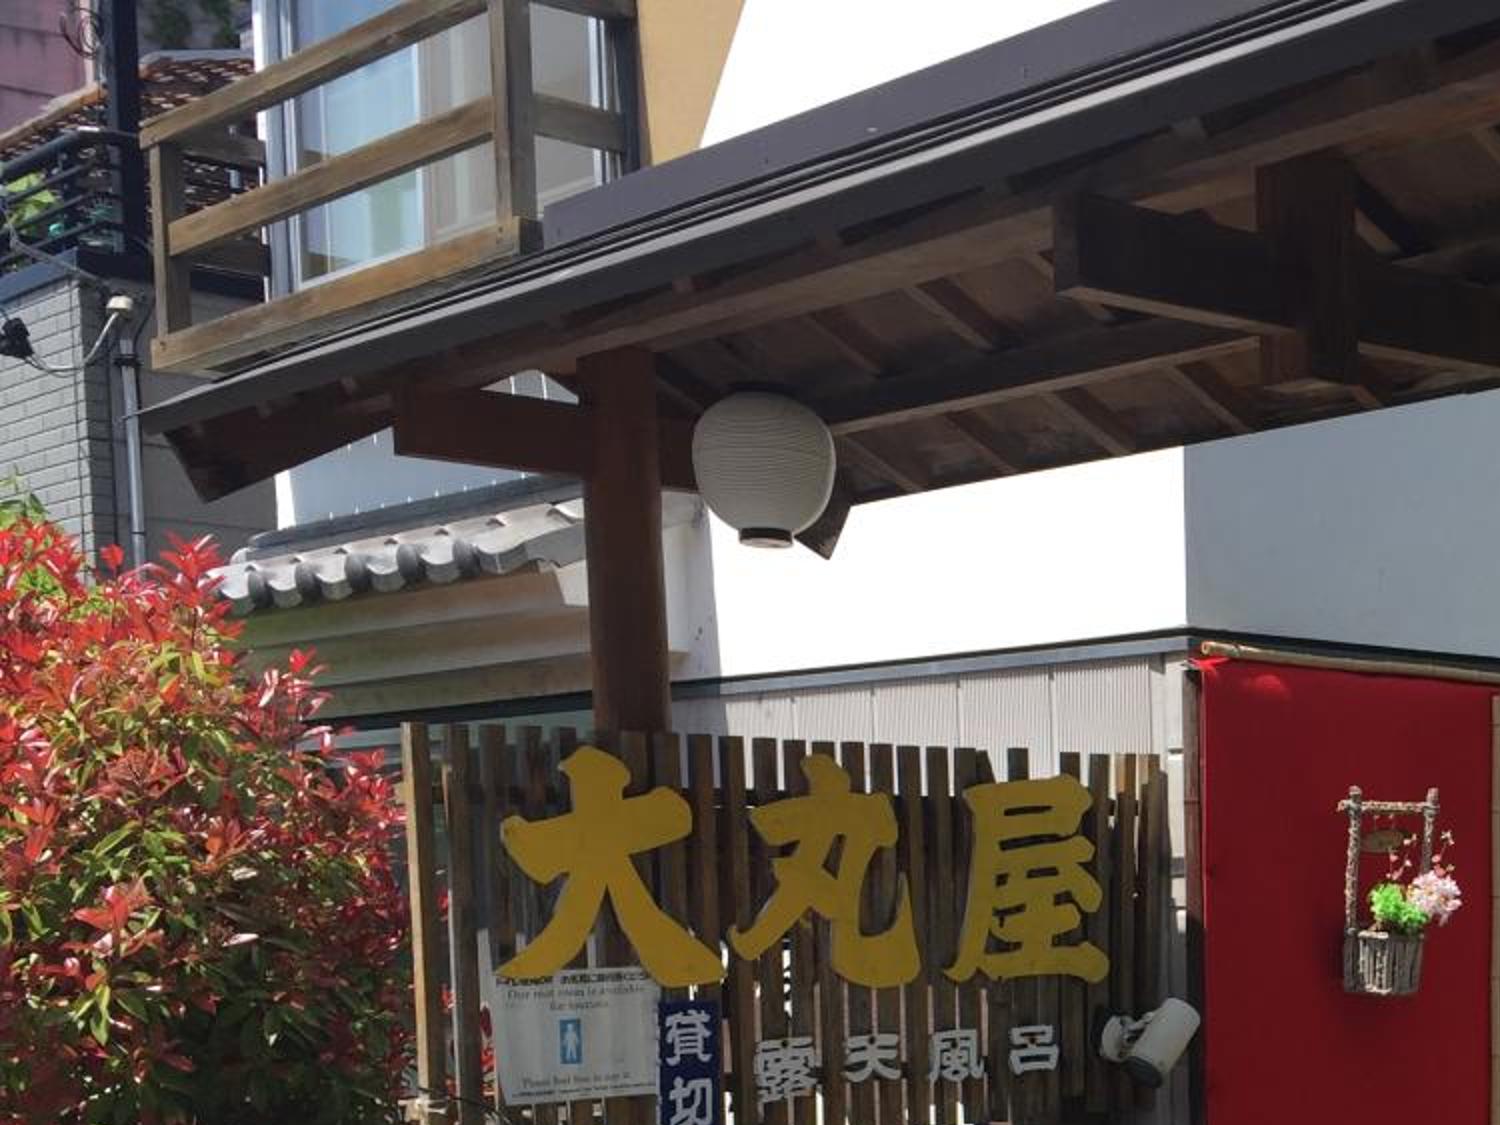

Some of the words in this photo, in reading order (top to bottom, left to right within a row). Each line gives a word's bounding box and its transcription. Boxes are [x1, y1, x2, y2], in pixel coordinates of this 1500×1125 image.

[498, 745, 1108, 988] 大丸屋
[754, 1025, 1059, 1104] 露天風呂
